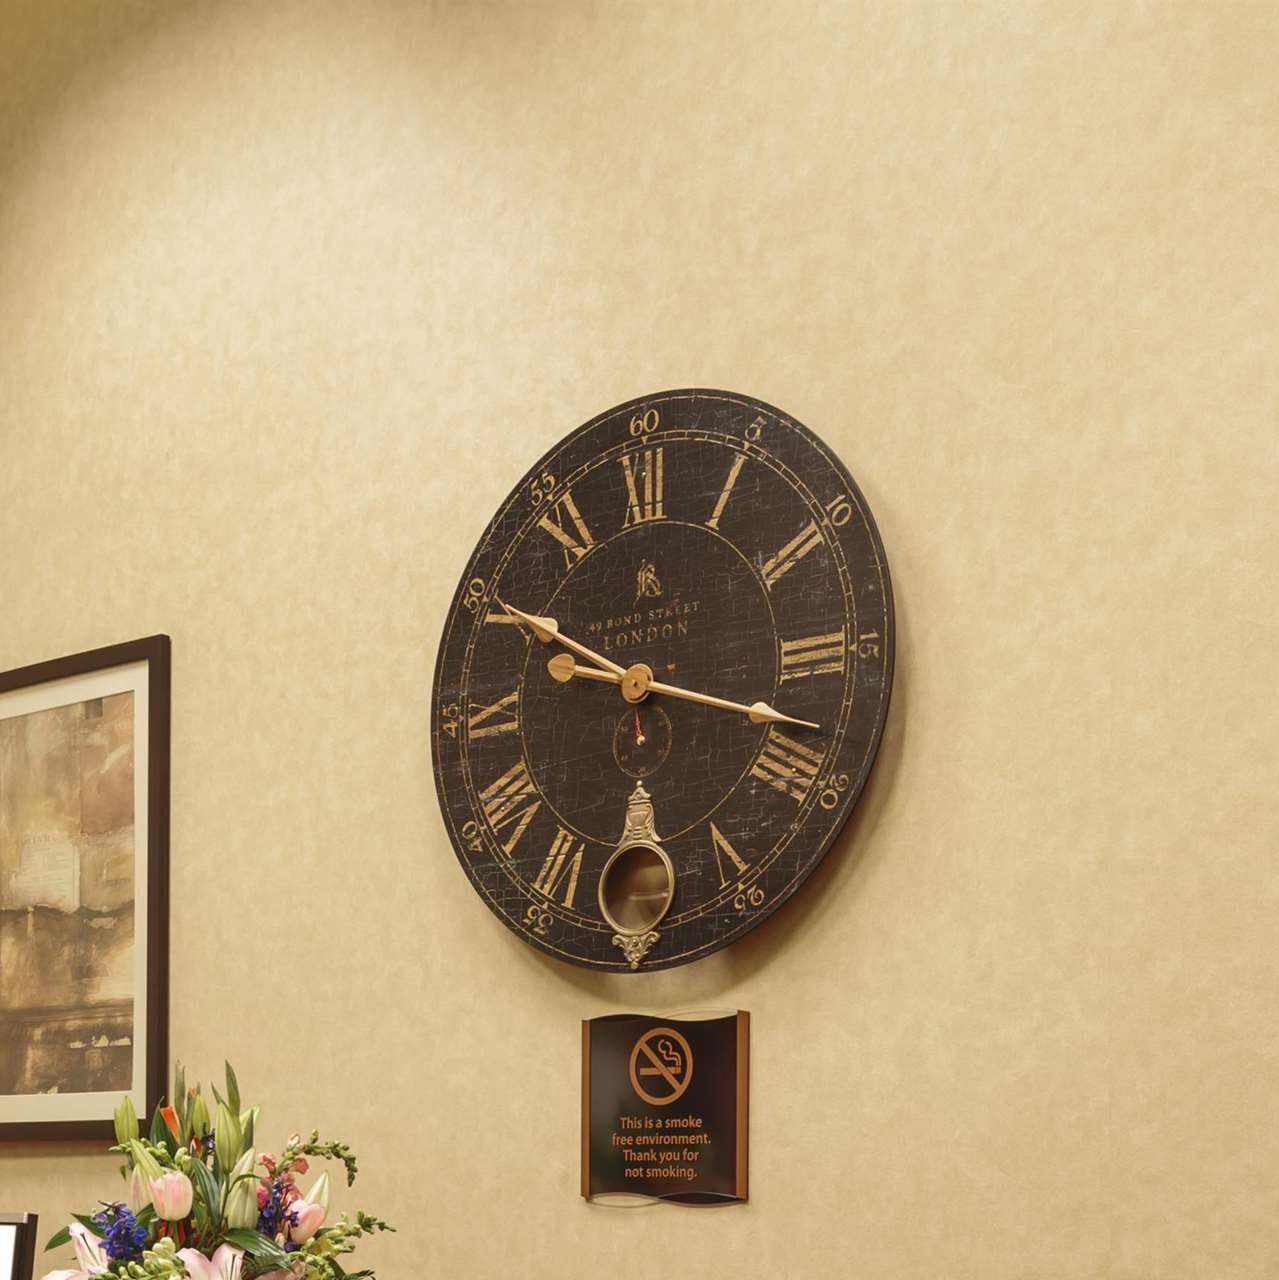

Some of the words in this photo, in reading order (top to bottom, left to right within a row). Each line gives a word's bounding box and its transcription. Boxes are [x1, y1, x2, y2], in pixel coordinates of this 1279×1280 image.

[630, 409, 659, 436] 60
[744, 416, 767, 441] 5
[529, 472, 555, 506] 55
[617, 447, 668, 529] XII
[705, 452, 748, 530] I
[825, 494, 852, 527] 10
[536, 489, 598, 571] XI
[761, 518, 825, 592] II
[464, 578, 485, 614] 50
[604, 620, 688, 651] LONDON
[607, 612, 641, 629] BOND
[779, 625, 846, 686] III
[858, 629, 880, 659] 15
[442, 703, 460, 738] 45
[468, 685, 520, 742] IX
[478, 755, 542, 859] VIII
[820, 773, 849, 810] 20
[461, 820, 483, 852] 40
[530, 825, 585, 910] VII
[710, 821, 751, 890] V
[734, 883, 765, 917] 25
[523, 905, 554, 936] 35
[612, 1132, 633, 1145] free
[635, 1132, 711, 1145] environment.
[620, 1116, 642, 1129] This
[645, 1116, 654, 1129] is
[655, 1119, 663, 1129] a
[665, 1115, 703, 1129] smoke
[623, 1148, 657, 1161] Thank
[659, 1151, 680, 1164] you
[683, 1148, 699, 1161] for
[624, 1167, 645, 1178] not
[646, 1165, 697, 1181] smoking.
